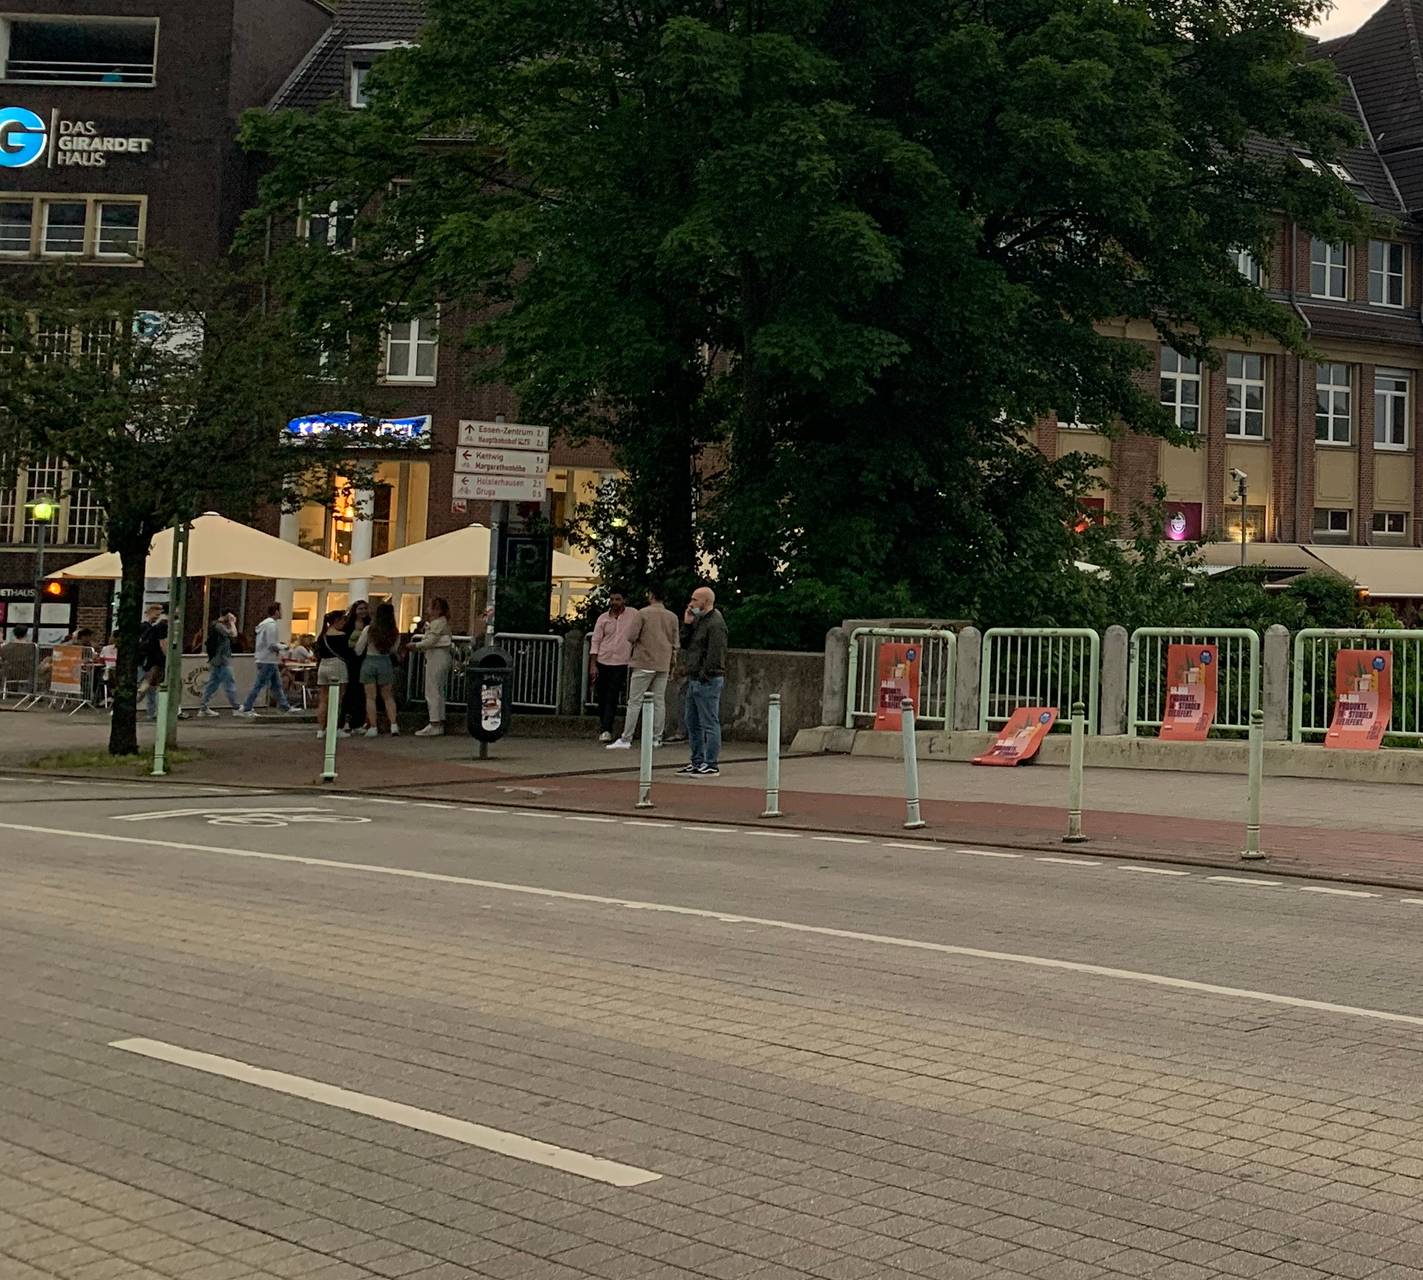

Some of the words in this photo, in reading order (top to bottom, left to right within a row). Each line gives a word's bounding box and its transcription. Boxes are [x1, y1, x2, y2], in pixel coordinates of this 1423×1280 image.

[59, 120, 97, 135] DAS
[58, 136, 152, 153] GIRARDET
[57, 151, 106, 167] HAUS
[479, 426, 533, 437] Essen-Zentrum
